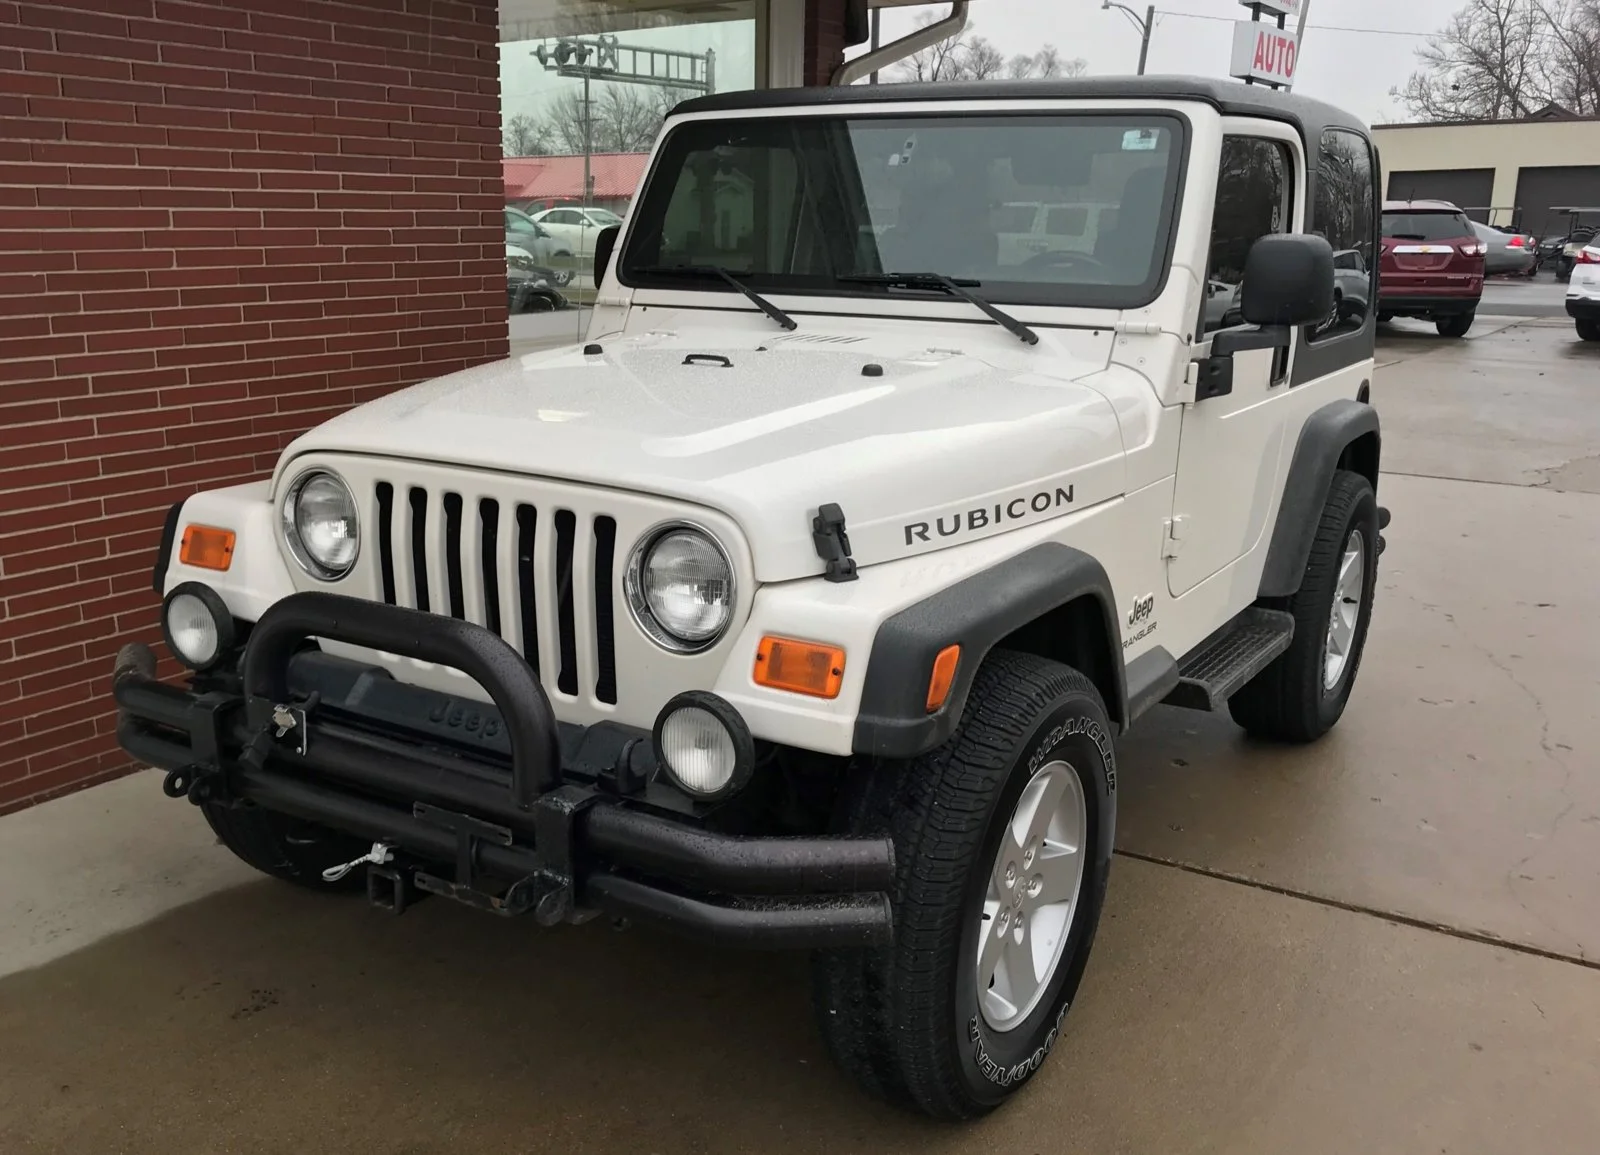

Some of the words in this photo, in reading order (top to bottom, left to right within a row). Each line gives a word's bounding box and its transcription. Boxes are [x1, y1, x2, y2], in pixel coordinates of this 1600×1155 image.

[1253, 30, 1295, 78] AUTO
[904, 484, 1074, 545] RUBICON
[1128, 595, 1154, 625] Jeep
[1121, 621, 1158, 649] RANGLER
[429, 698, 503, 739] Jeep
